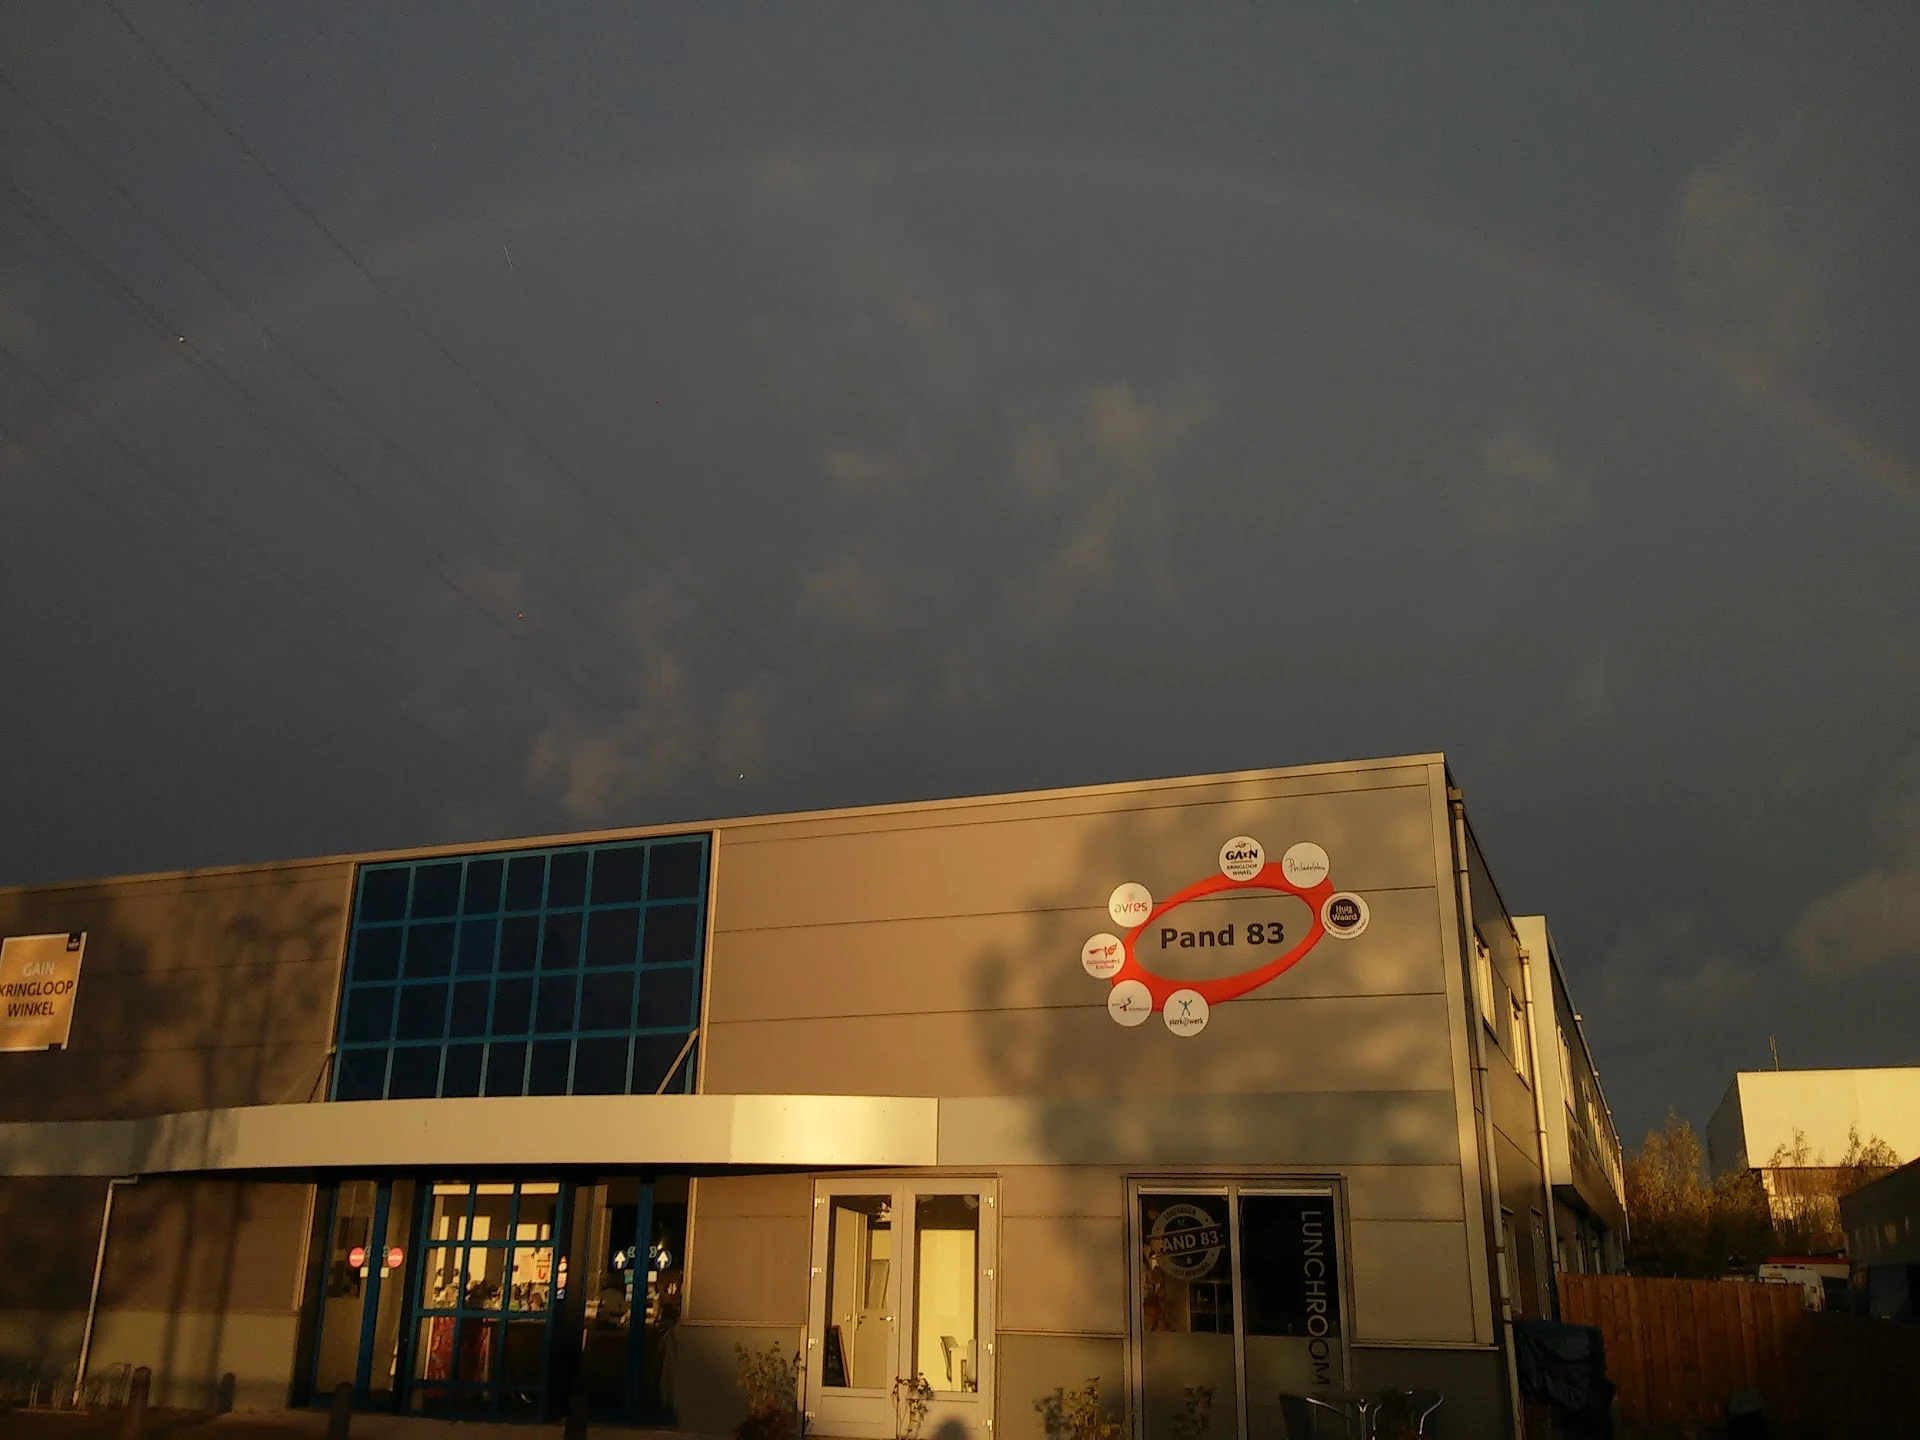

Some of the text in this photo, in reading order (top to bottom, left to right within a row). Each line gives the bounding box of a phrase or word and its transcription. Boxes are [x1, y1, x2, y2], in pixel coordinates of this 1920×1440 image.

[1114, 901, 1148, 914] avres
[1160, 921, 1285, 949] Pand 83
[23, 961, 56, 977] GAIN
[8, 1001, 55, 1018] WINKEL
[1161, 1229, 1219, 1253] AND 83
[1300, 1209, 1331, 1386] LUNCHROOM
